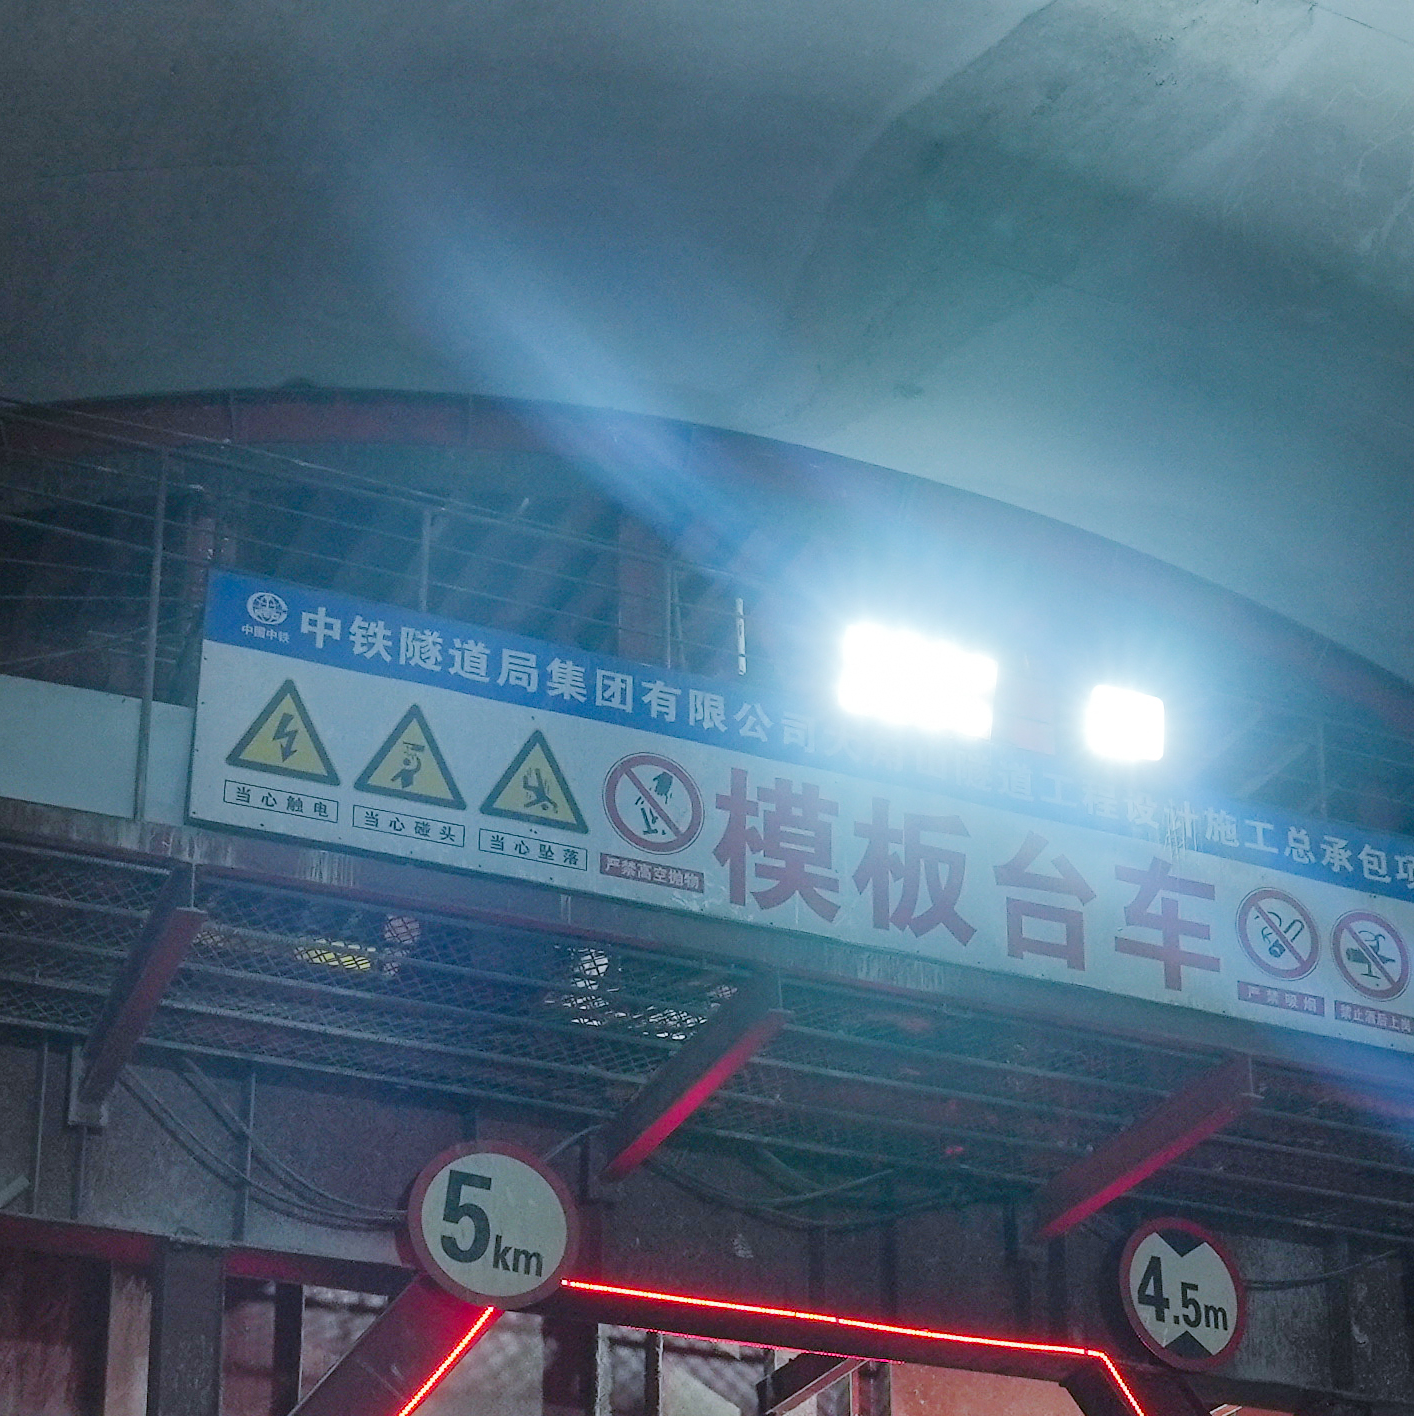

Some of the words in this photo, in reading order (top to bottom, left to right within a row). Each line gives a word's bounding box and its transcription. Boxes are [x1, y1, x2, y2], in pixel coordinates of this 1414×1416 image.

[241, 624, 289, 643] 中国中铁
[234, 785, 329, 819] 当心触电
[363, 810, 457, 843] 当心碰头
[489, 833, 579, 867] 当心坠落
[605, 859, 700, 890] 严禁高空抛物
[713, 767, 1220, 991] 模板台车
[1246, 985, 1317, 1013] 严禁吸烟
[441, 1169, 544, 1278] 5km
[1138, 1256, 1228, 1331] 4.5m
